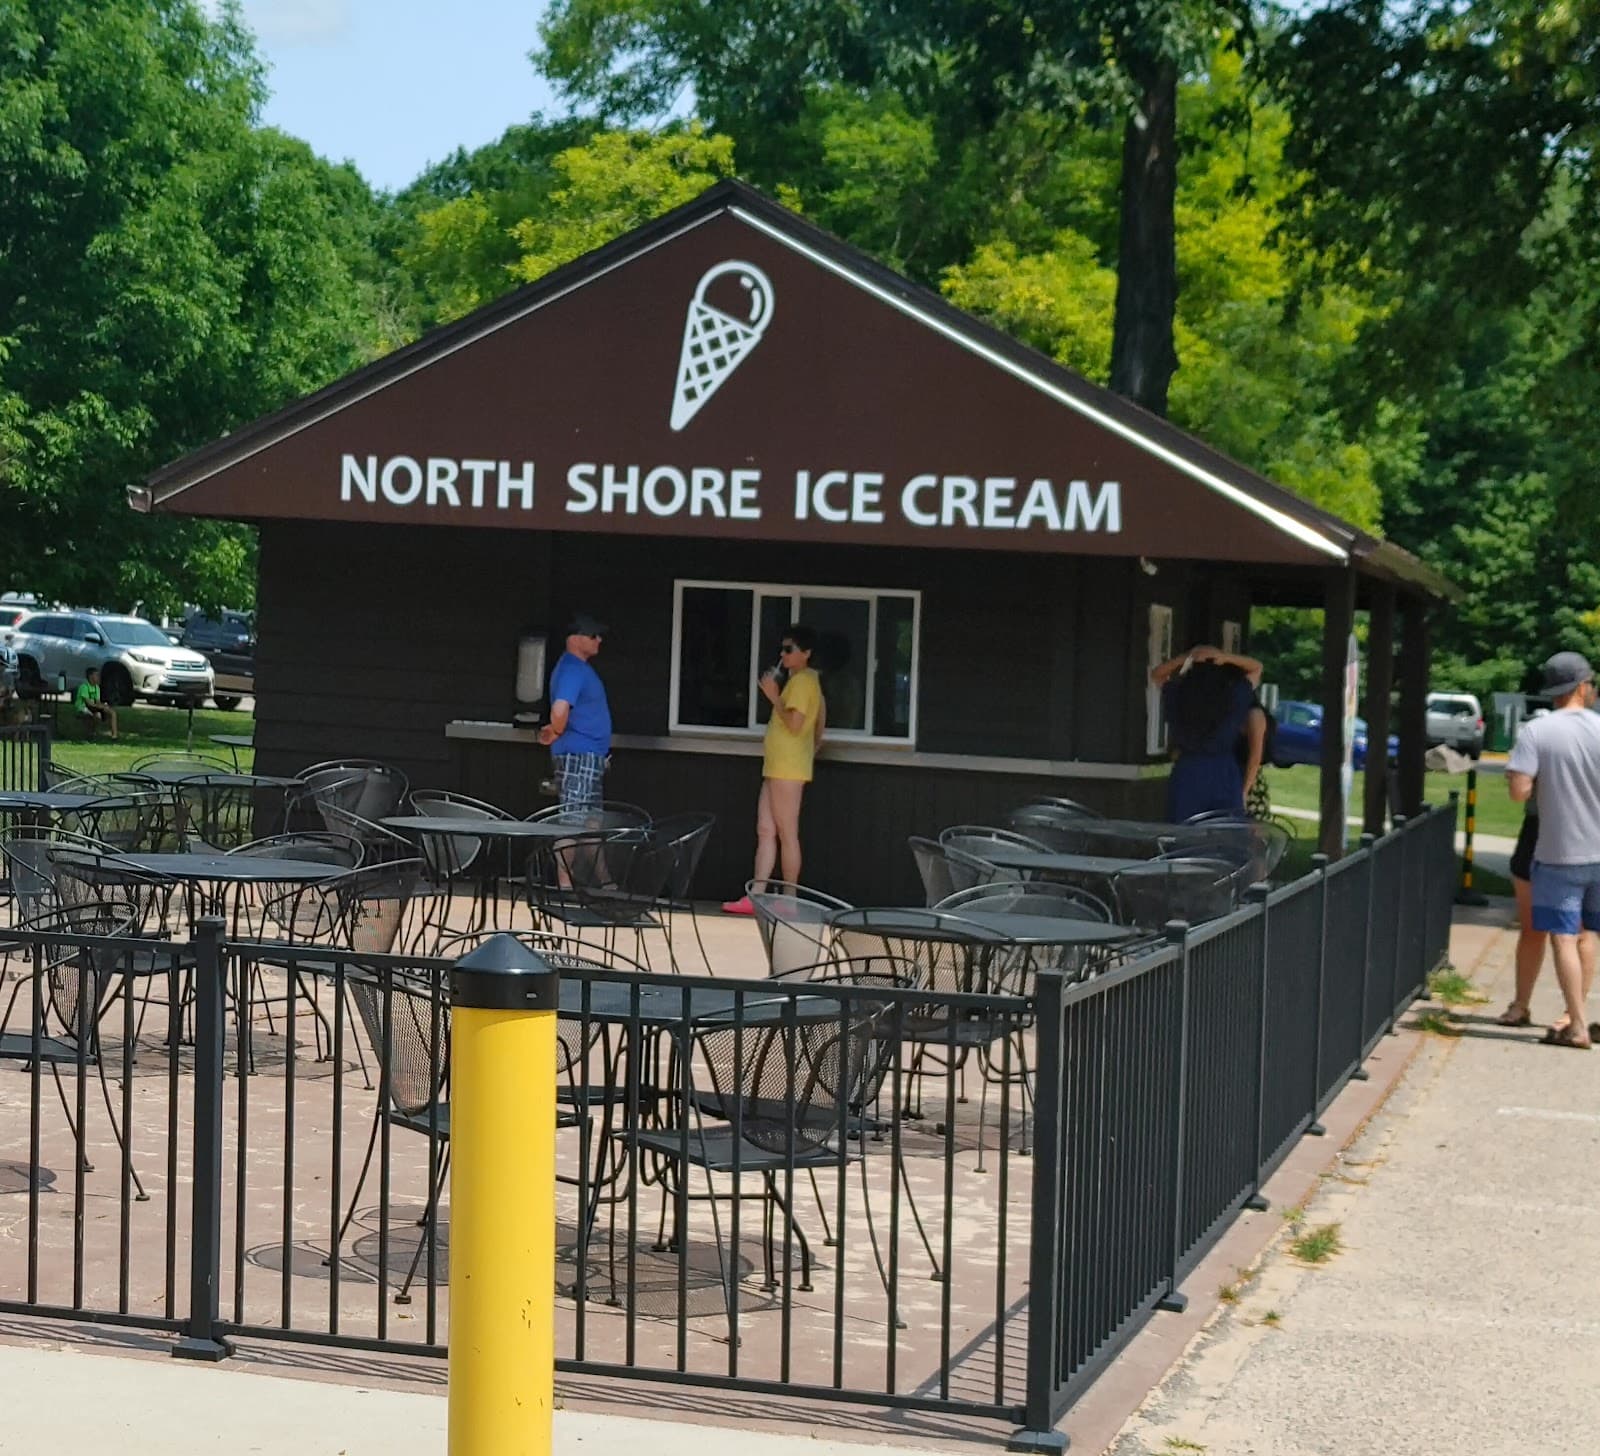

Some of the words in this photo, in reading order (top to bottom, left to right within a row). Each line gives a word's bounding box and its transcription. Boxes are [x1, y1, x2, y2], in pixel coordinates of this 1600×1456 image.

[340, 453, 535, 511] NORTH
[564, 462, 762, 520] SHORE
[795, 470, 884, 525] ICE
[900, 474, 1122, 534] CREAM
